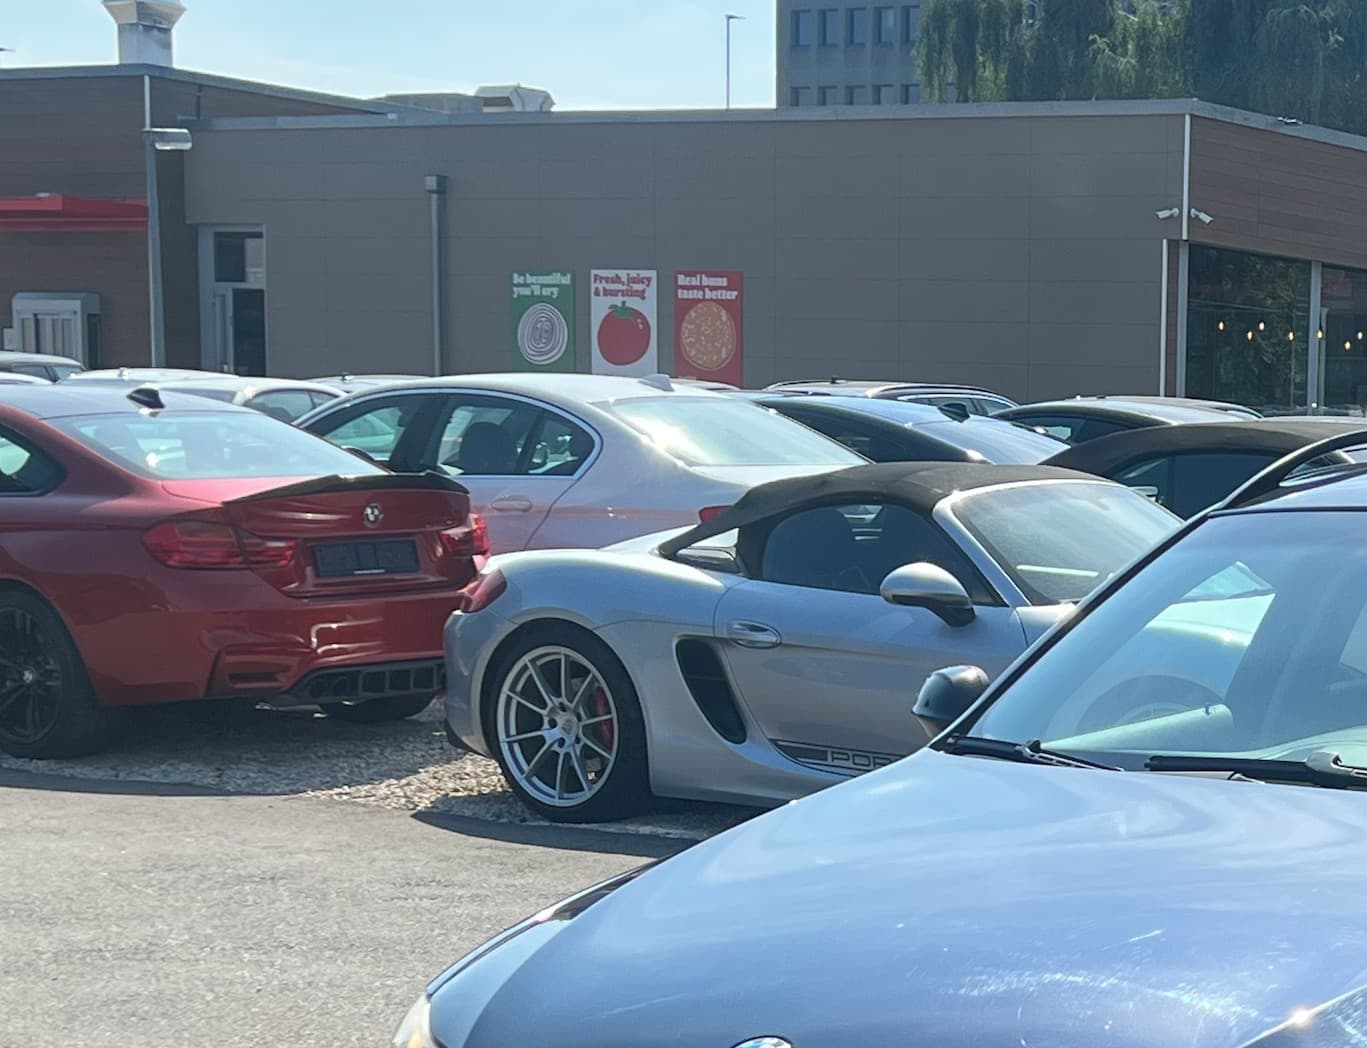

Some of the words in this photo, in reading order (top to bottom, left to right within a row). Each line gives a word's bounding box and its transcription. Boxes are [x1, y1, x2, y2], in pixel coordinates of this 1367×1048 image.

[526, 272, 571, 285] beautiful
[593, 273, 625, 286] Fresh,
[626, 272, 653, 288] juicy
[676, 273, 701, 286] Real
[702, 274, 728, 286] buns
[542, 287, 560, 299] cry
[593, 286, 601, 297] &
[602, 286, 647, 300] bursting
[677, 288, 704, 299] taste
[704, 287, 739, 300] better
